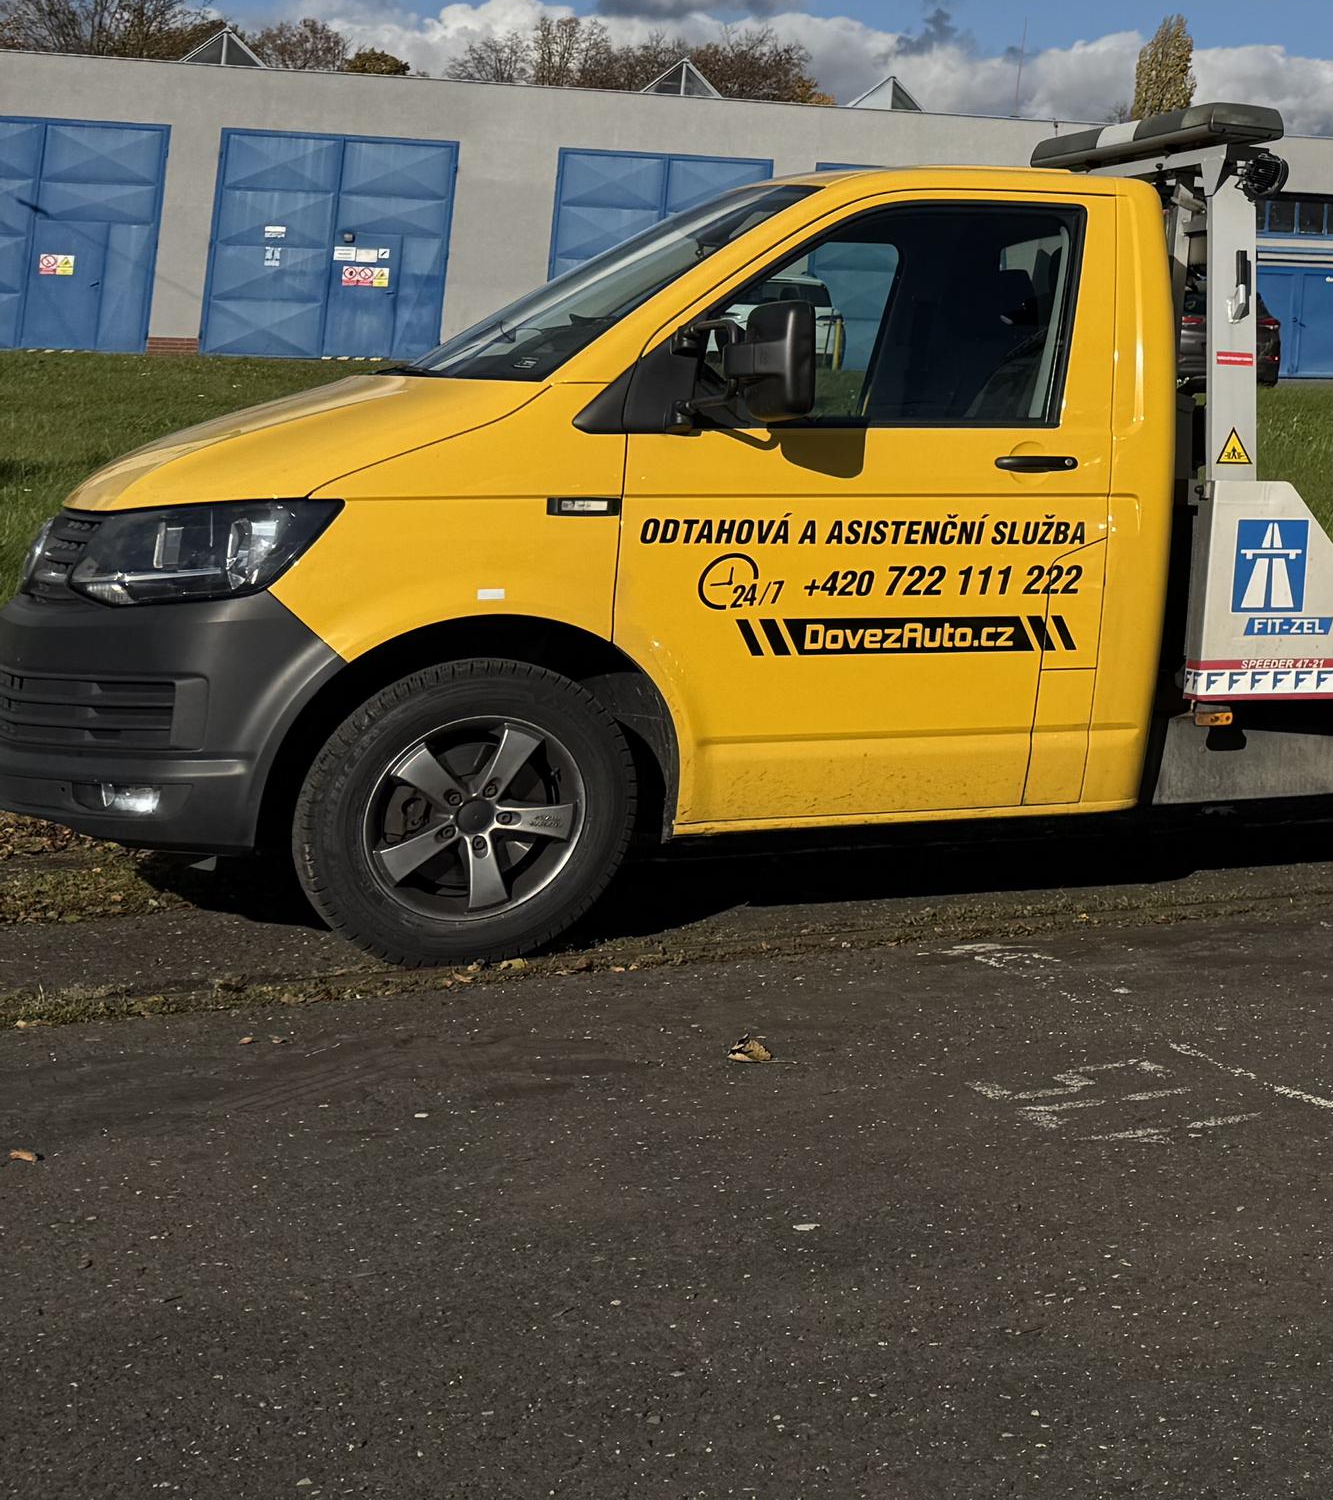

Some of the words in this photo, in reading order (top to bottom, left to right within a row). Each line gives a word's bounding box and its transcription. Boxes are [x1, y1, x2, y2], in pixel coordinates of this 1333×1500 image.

[640, 512, 793, 545] ODTAHOVÁ
[798, 520, 816, 545] A
[825, 513, 990, 545] ASISTENČNÍ
[991, 514, 1086, 545] SLUŽBA
[730, 580, 785, 608] 24/7
[804, 570, 875, 597] +420
[885, 565, 946, 596] 722
[958, 565, 1012, 596] 111
[1022, 565, 1083, 595] 222
[804, 622, 1015, 650] DovezAuto.cz
[1253, 618, 1325, 634] FIT-ZEL
[1241, 660, 1293, 670] SPEEDER
[1295, 659, 1325, 669] 47-21
